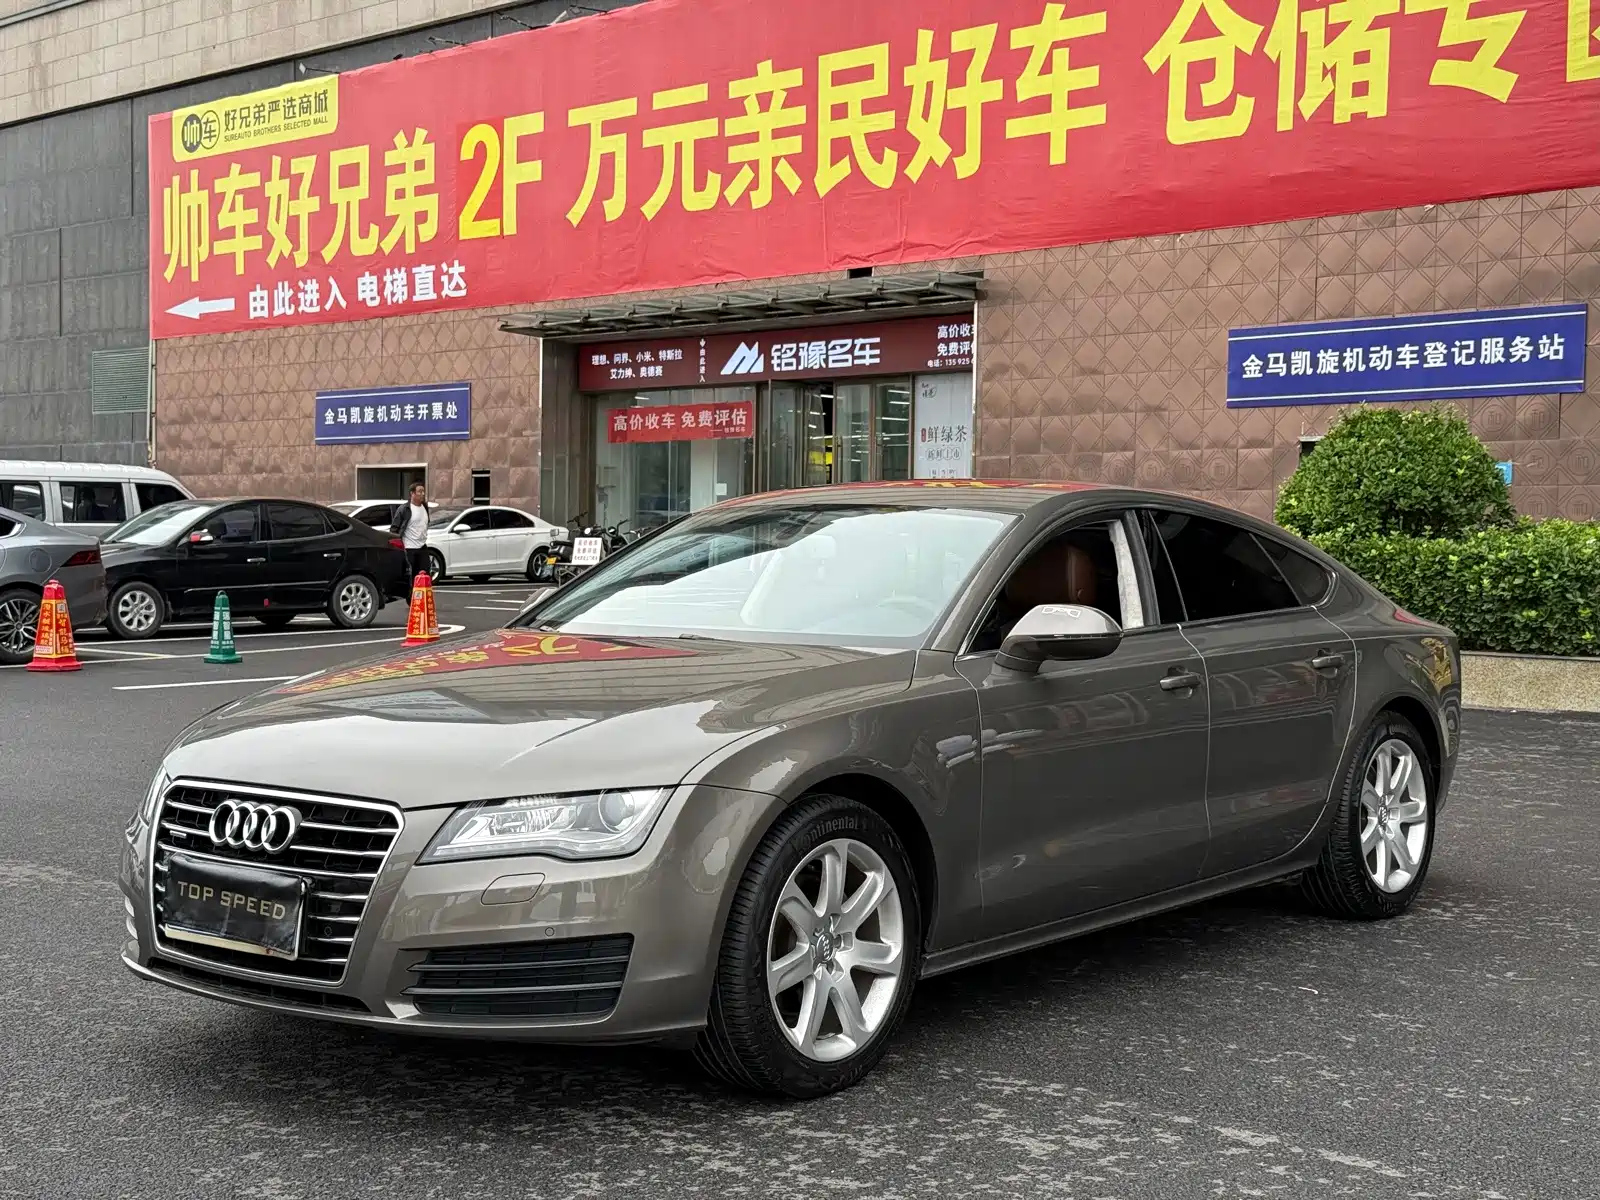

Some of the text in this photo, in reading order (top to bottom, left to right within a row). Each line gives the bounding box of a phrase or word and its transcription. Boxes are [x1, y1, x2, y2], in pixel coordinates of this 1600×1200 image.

[224, 89, 328, 132] 好兄弟严选商城
[224, 116, 328, 142] SUREAUTO BROTHERS SELECTED MALL
[163, 128, 439, 283] 帅车好兄弟
[459, 111, 544, 240] 2F
[565, 2, 1107, 228] 万元亲民好车
[248, 260, 467, 320] 由此进入 电梯直达
[770, 337, 881, 372] 铭豫名车
[1242, 333, 1566, 379] 金马凯旋机动车登记服务站
[324, 401, 458, 425] 金马凯旋机动车开票处
[613, 407, 747, 432] 高价收车 免费评估
[927, 424, 967, 443] 鲜绿茶
[177, 880, 286, 921] TOP SPEED
